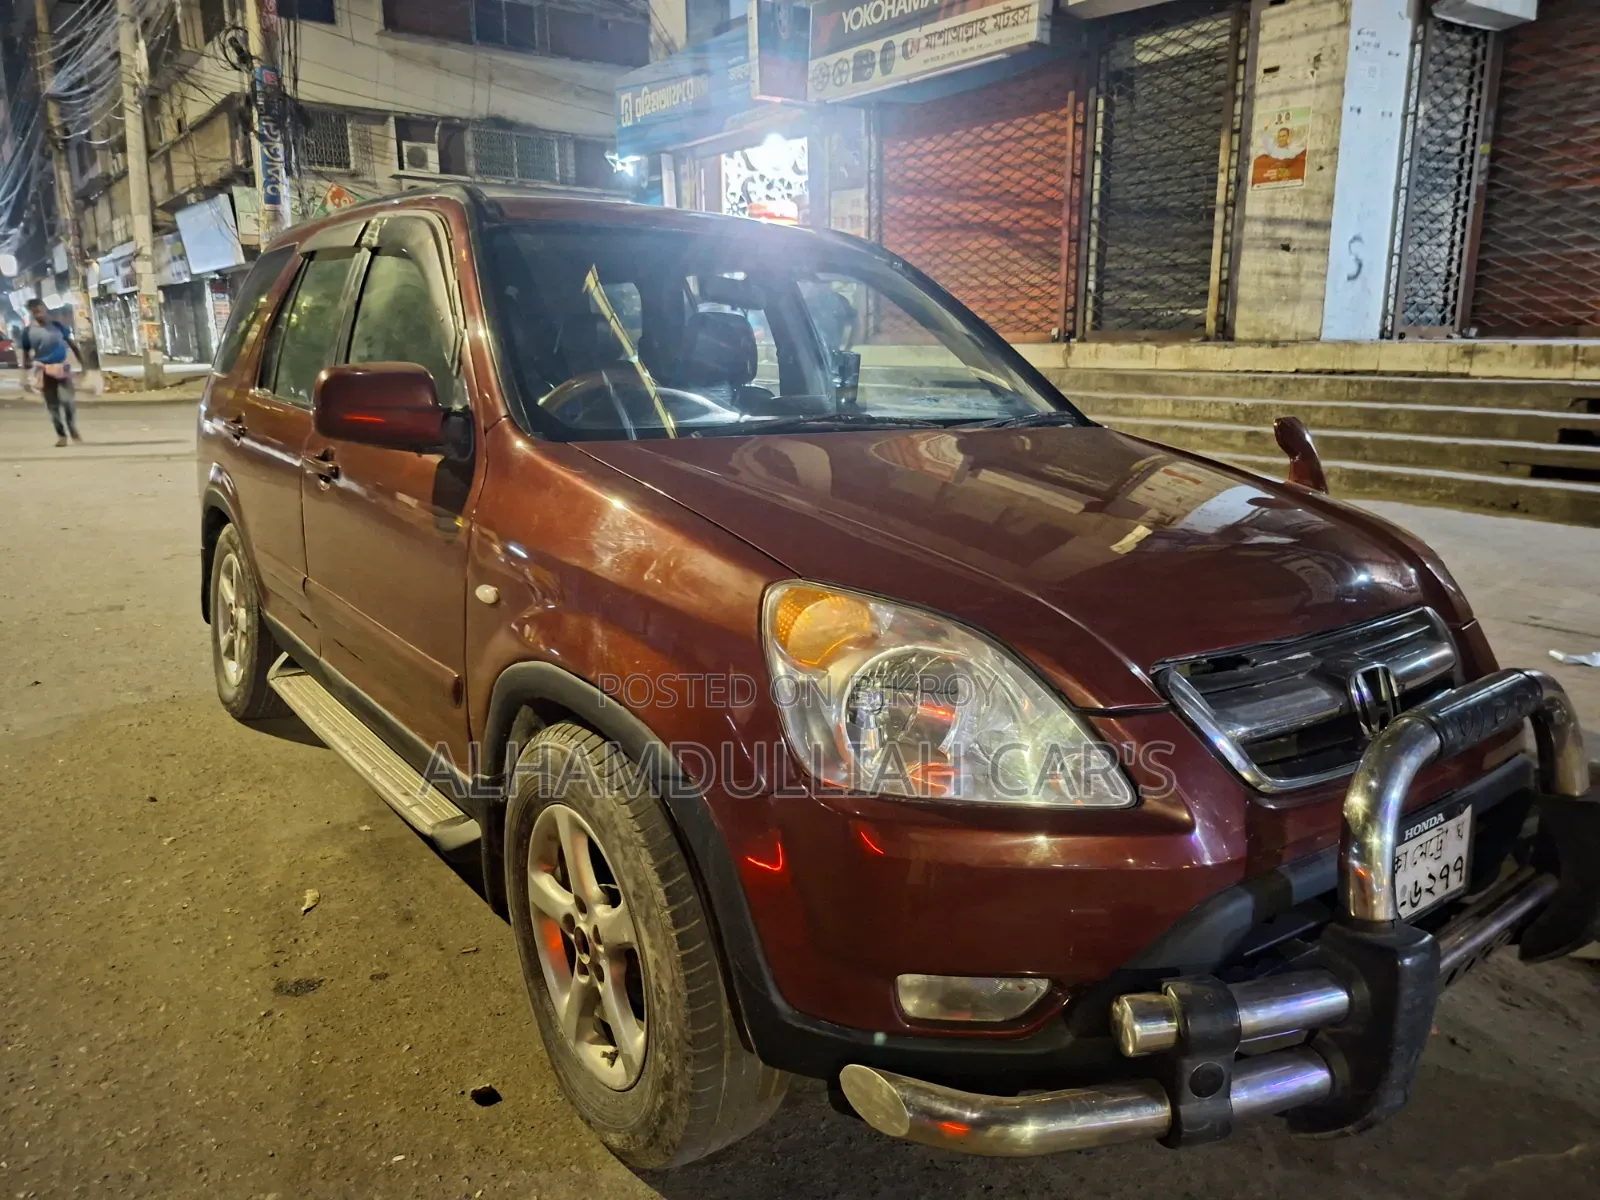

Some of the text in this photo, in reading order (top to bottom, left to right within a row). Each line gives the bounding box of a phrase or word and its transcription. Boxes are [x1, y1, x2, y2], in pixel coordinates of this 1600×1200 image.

[842, 0, 938, 34] YOKOHAM
[992, 4, 1032, 32] মটরস
[1404, 813, 1445, 841] HONDA
